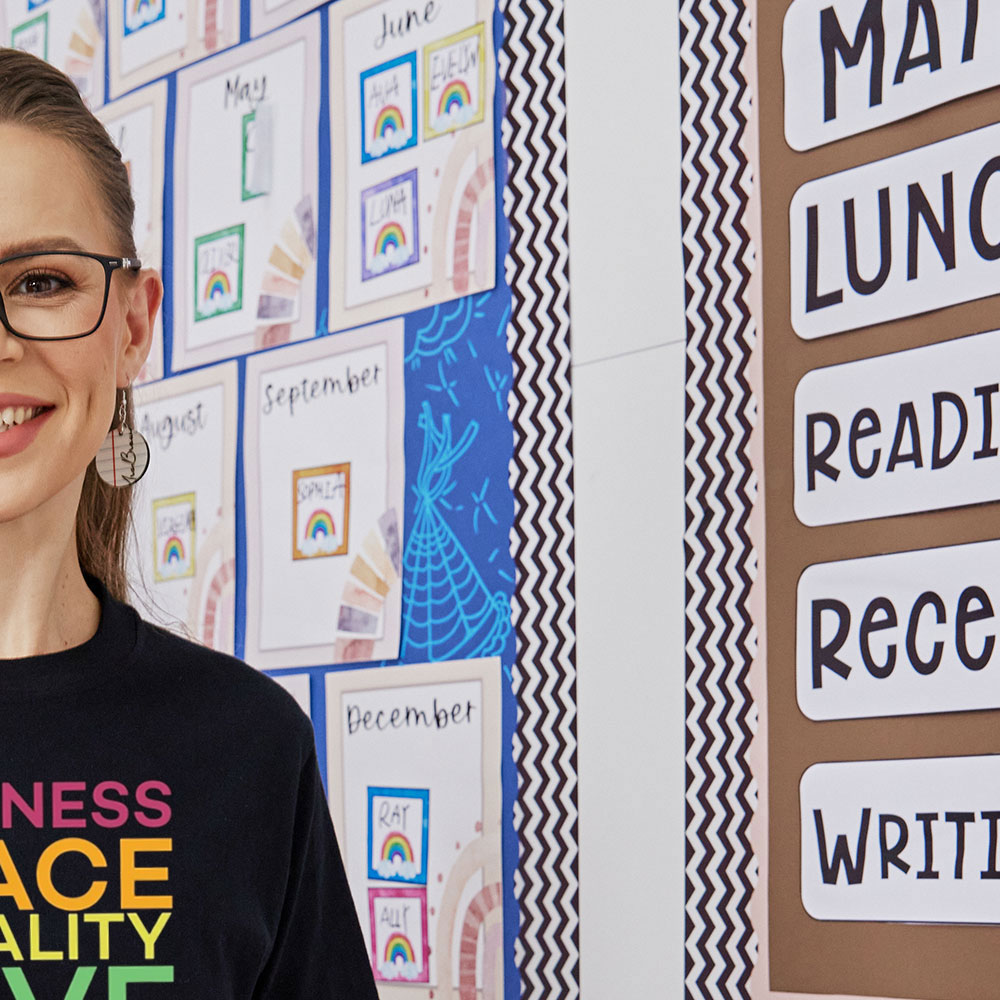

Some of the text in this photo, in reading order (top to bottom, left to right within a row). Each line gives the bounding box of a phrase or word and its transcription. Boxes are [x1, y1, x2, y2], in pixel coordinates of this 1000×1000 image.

[375, 0, 440, 49] June
[224, 74, 266, 110] May
[805, 155, 1000, 313] LUNC
[263, 363, 381, 416] September
[141, 403, 206, 451] August
[347, 698, 475, 735] December
[813, 808, 1000, 885] WRITI
